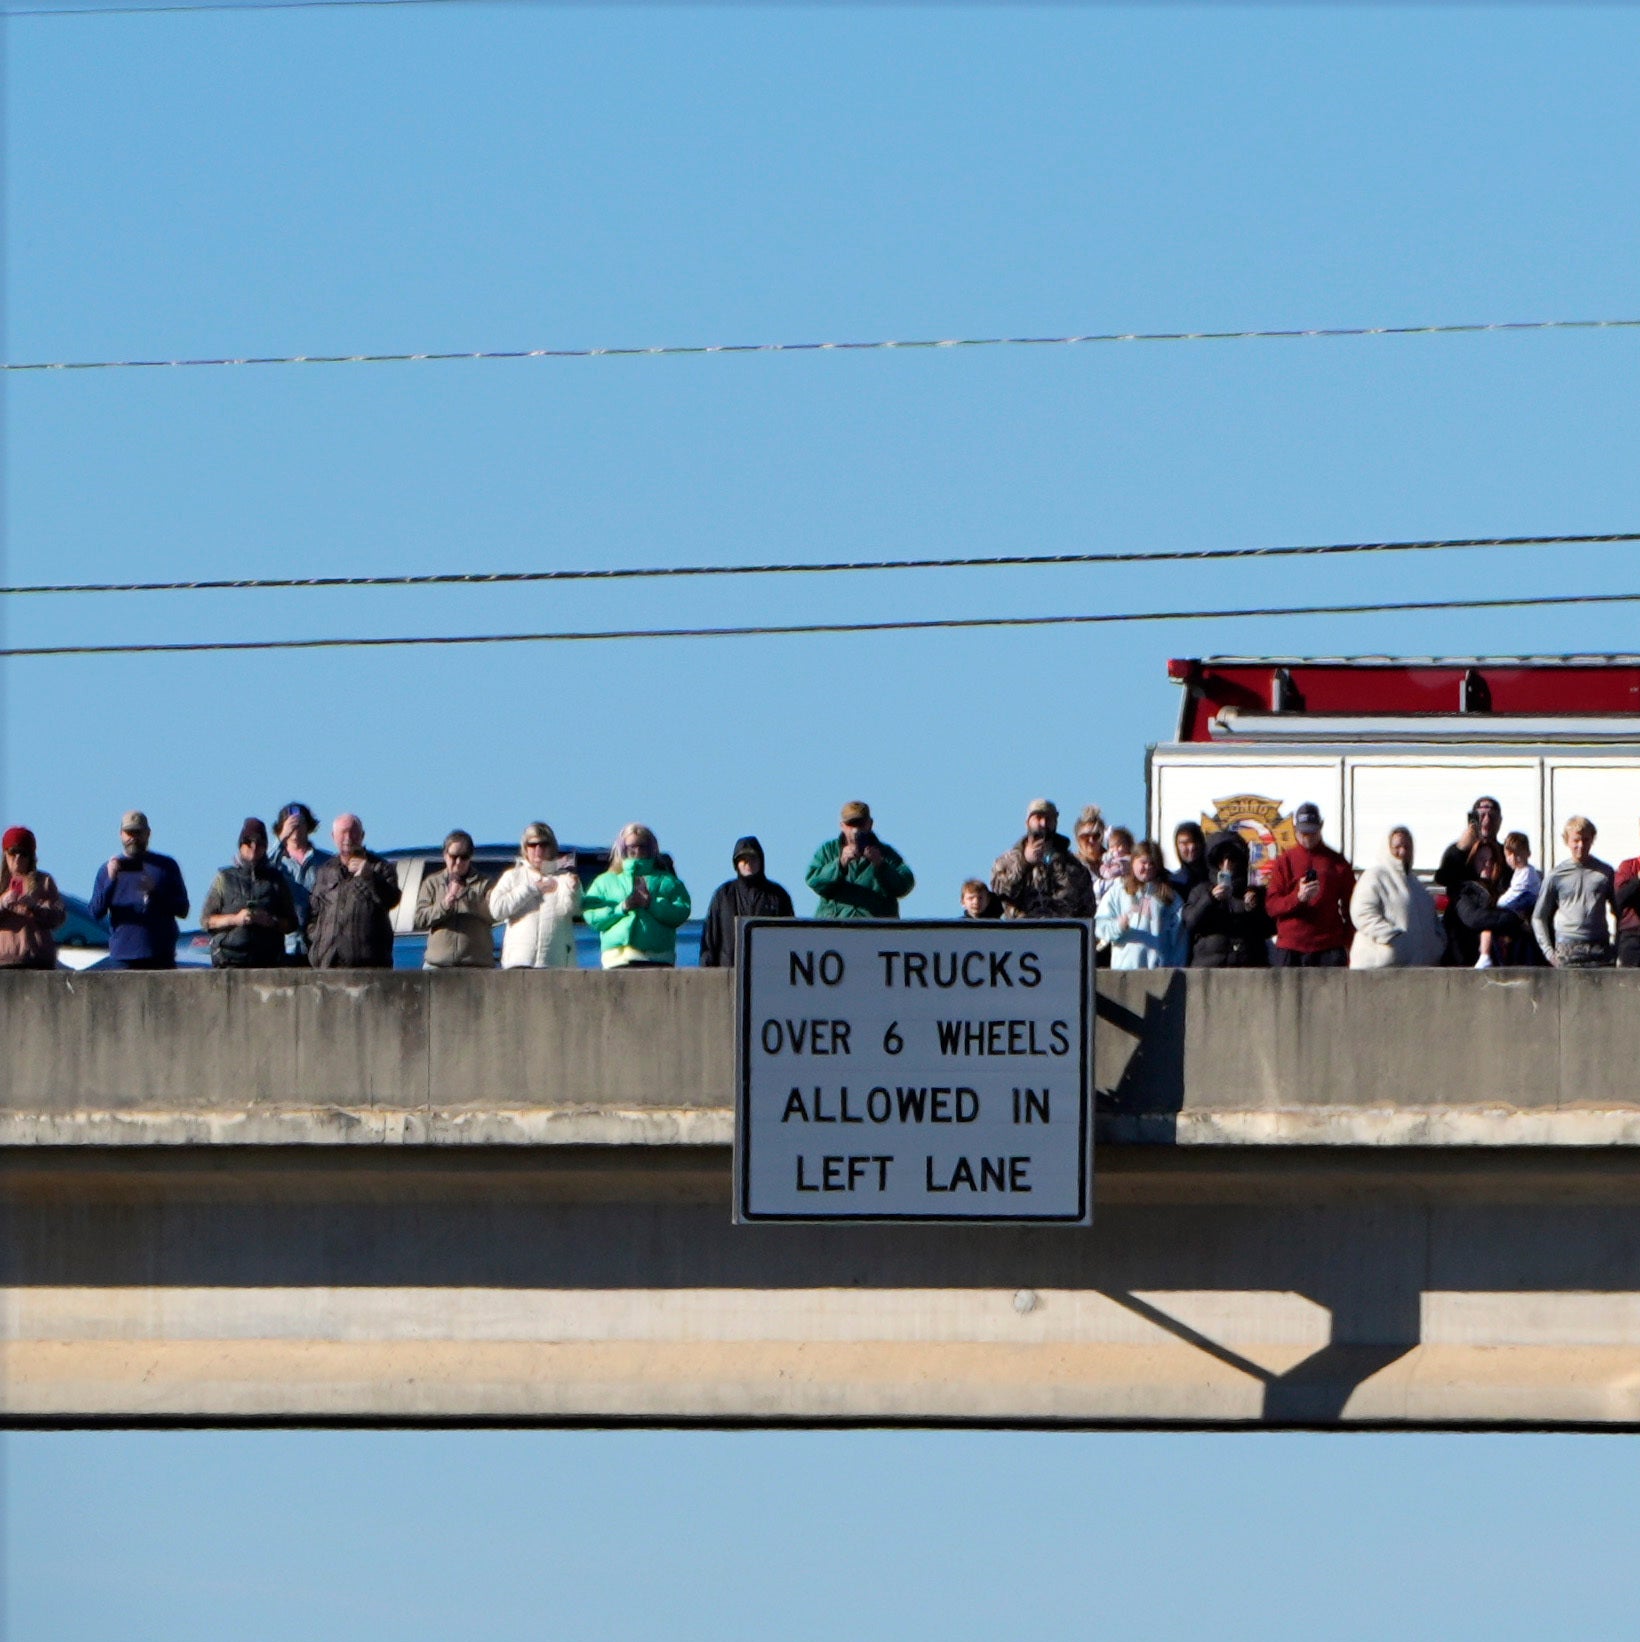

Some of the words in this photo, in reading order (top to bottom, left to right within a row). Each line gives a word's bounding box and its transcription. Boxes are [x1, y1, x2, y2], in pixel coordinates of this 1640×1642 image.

[789, 949, 844, 986] NO
[878, 950, 1042, 988] TRUCKS
[761, 1018, 852, 1055] OVER
[883, 1020, 904, 1055] 6
[937, 1020, 1071, 1056] WHEELS
[781, 1087, 980, 1124] ALLOWED
[1012, 1088, 1050, 1124] IN
[796, 1155, 894, 1192] LEFT
[926, 1156, 1032, 1193] LANE
